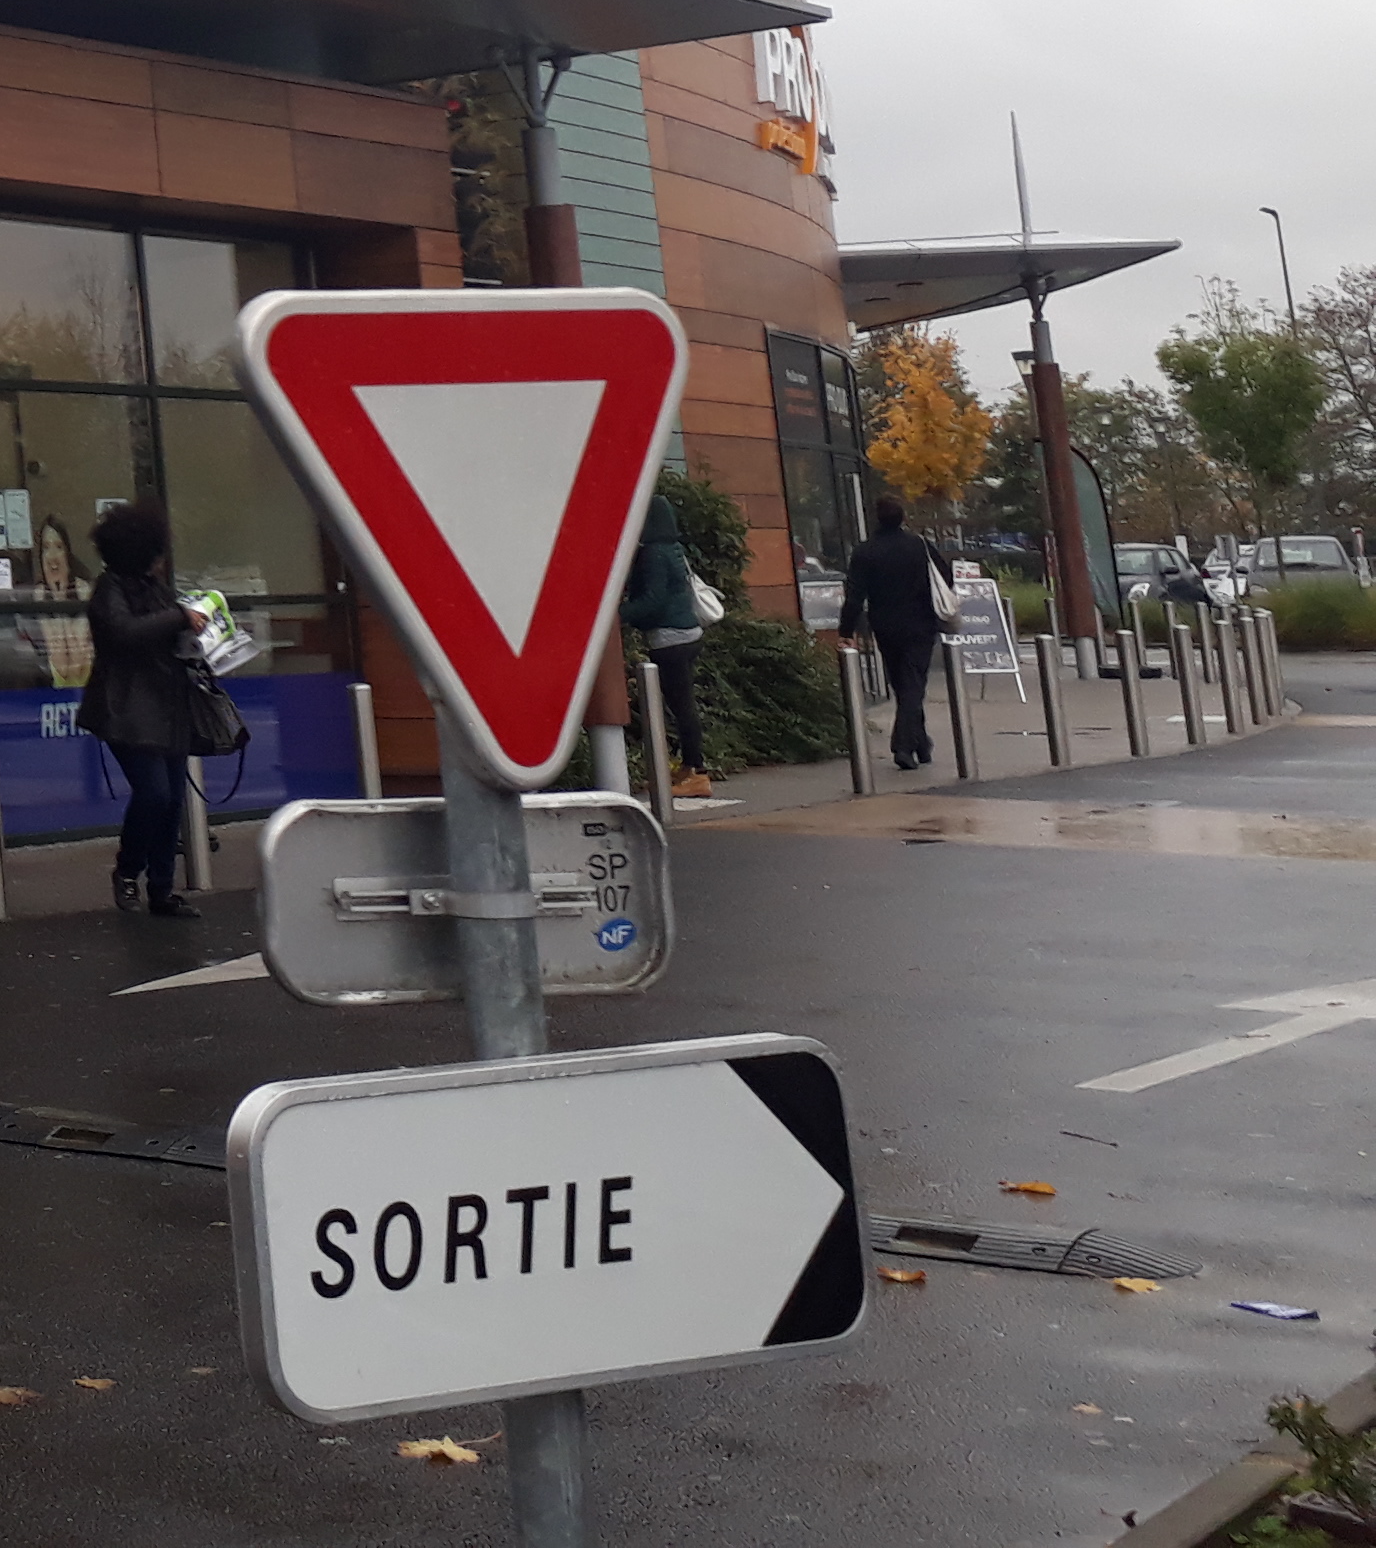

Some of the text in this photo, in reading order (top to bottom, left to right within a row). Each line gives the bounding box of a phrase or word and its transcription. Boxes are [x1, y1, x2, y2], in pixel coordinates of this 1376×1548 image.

[40, 701, 93, 739] ACT
[588, 853, 628, 880] SP
[601, 924, 634, 945] NF
[310, 1175, 634, 1300] SORTIE
